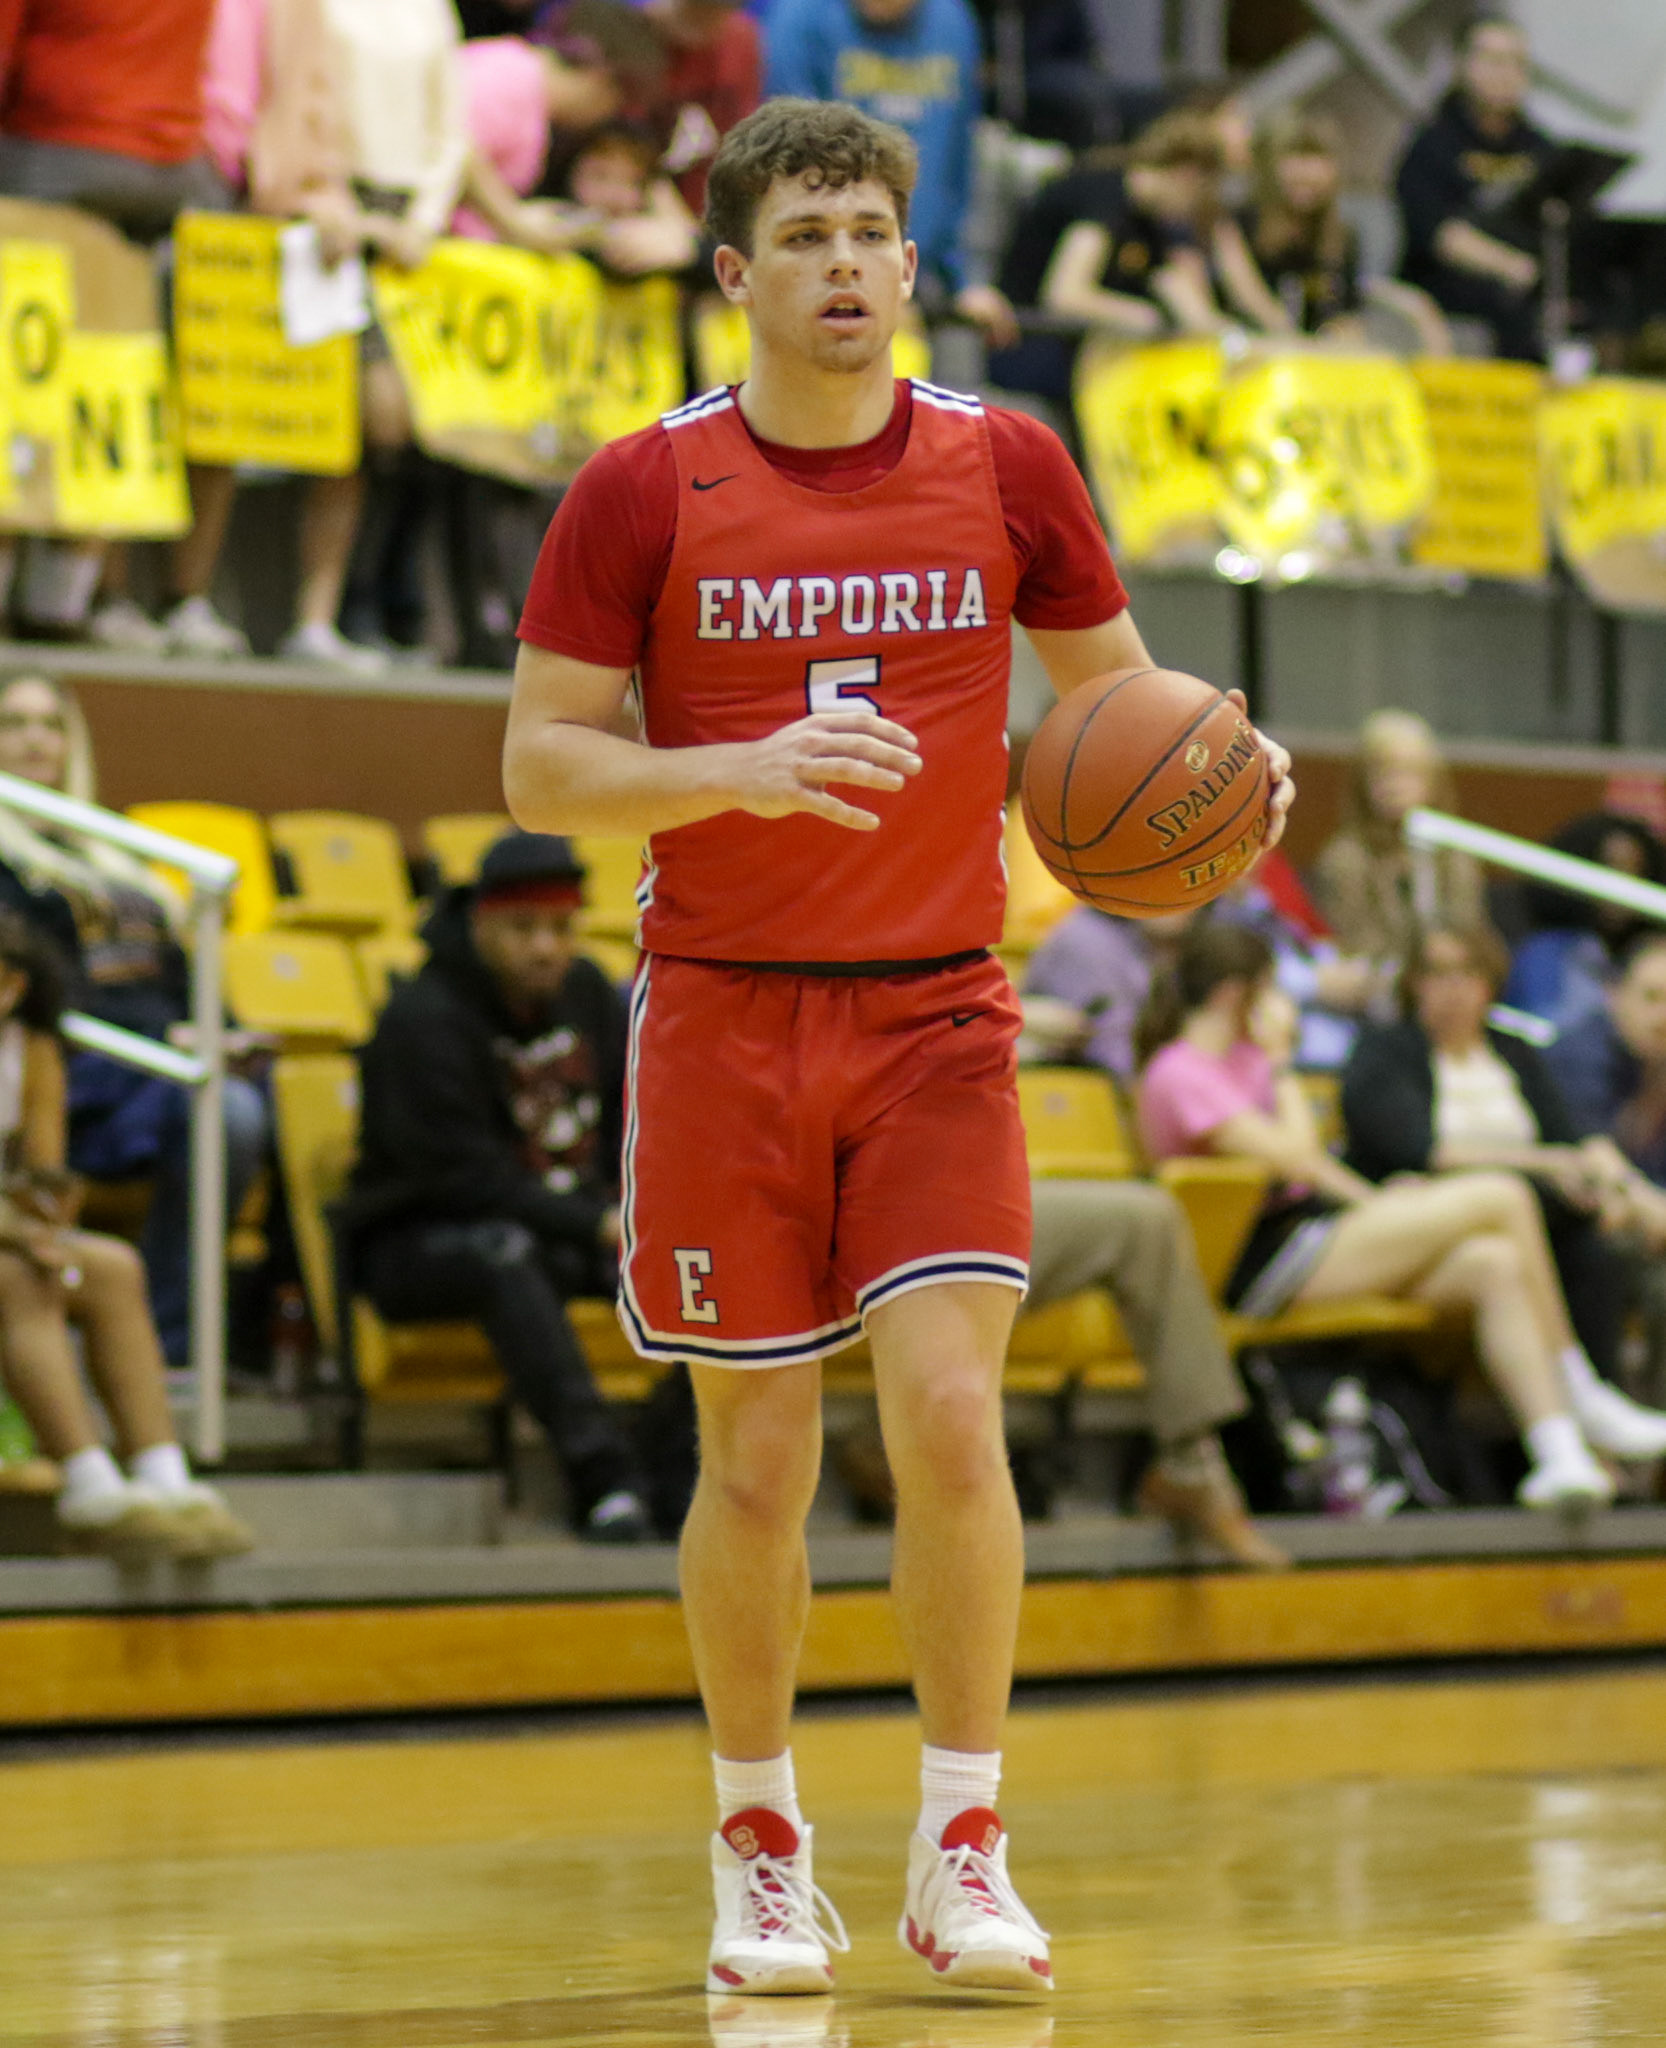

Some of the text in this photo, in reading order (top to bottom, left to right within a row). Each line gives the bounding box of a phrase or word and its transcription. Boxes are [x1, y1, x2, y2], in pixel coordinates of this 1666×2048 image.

[697, 568, 988, 640] EMPORIA
[805, 654, 882, 717] 5
[673, 1247, 720, 1325] E
